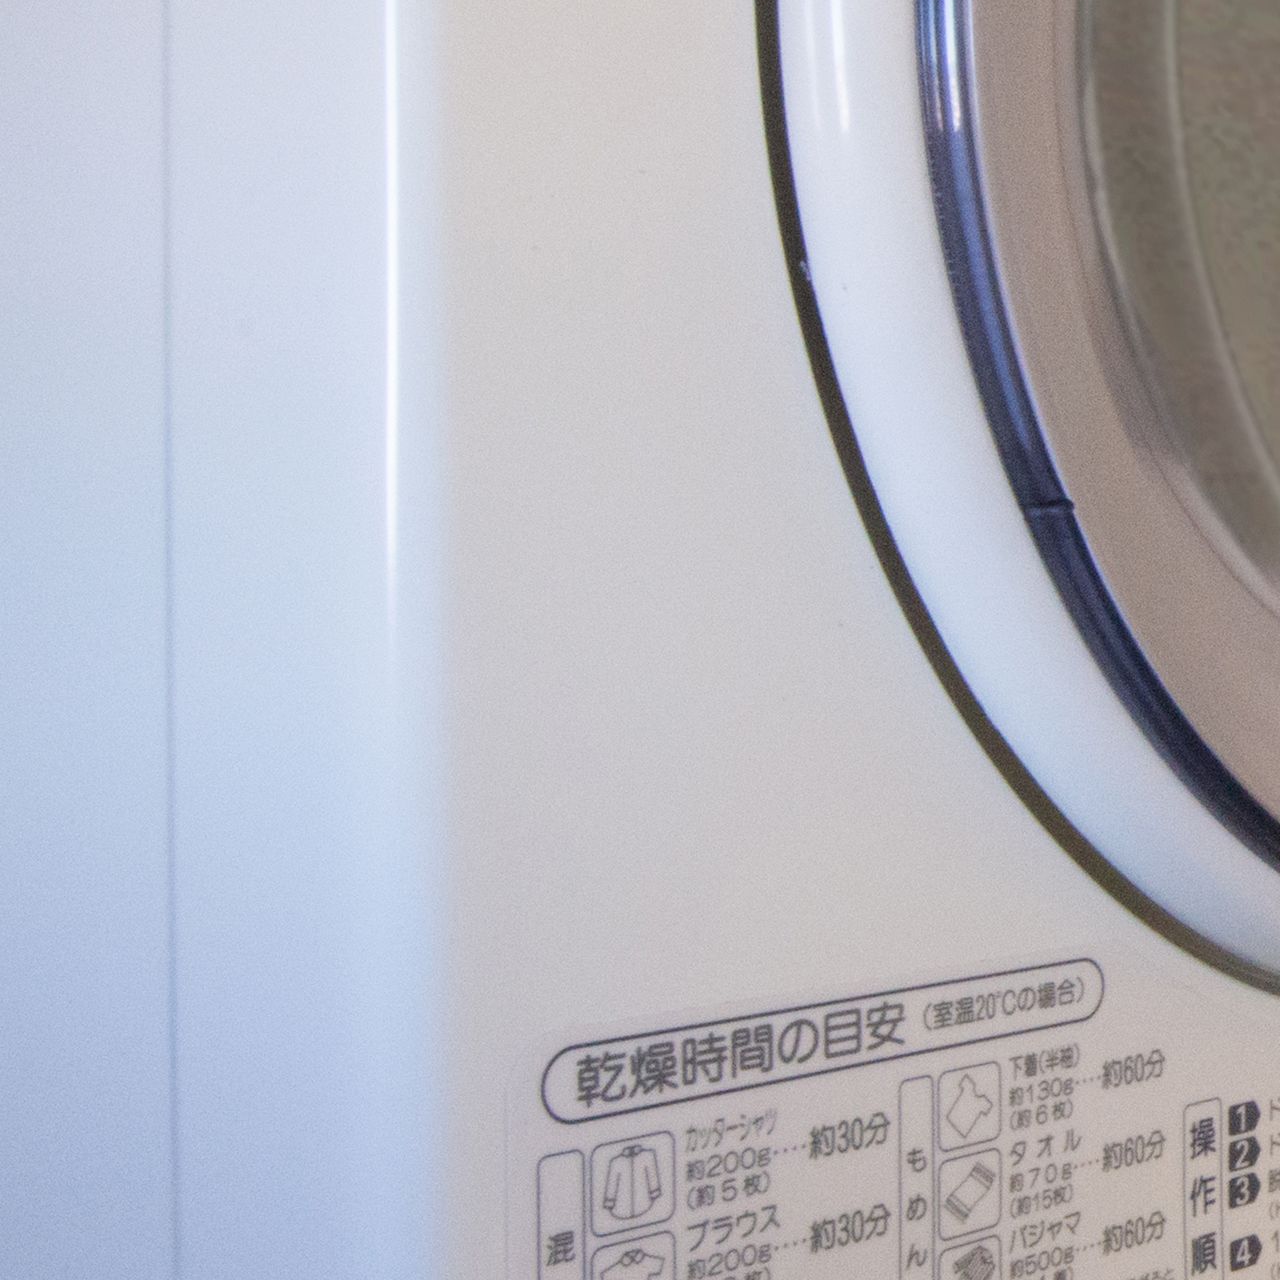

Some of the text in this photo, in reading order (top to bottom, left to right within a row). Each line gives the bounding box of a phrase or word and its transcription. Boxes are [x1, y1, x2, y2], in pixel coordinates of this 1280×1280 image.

[576, 1001, 905, 1108] 乾燥時間の目安
[1101, 1048, 1166, 1090] 約60分
[685, 1108, 779, 1153] カッターシャツ
[808, 1111, 891, 1161] 約30分
[1010, 1128, 1082, 1167] タオル
[1101, 1129, 1167, 1173] 約60分
[1235, 1139, 1250, 1168] 2
[907, 1148, 928, 1268] もめん
[1234, 1175, 1250, 1206] 3
[686, 1204, 780, 1253] ブラウス
[809, 1202, 892, 1254] 約30分
[1009, 1211, 1082, 1254] パジャマ
[1101, 1209, 1167, 1256] 約60分
[1235, 1238, 1251, 1268] 4
